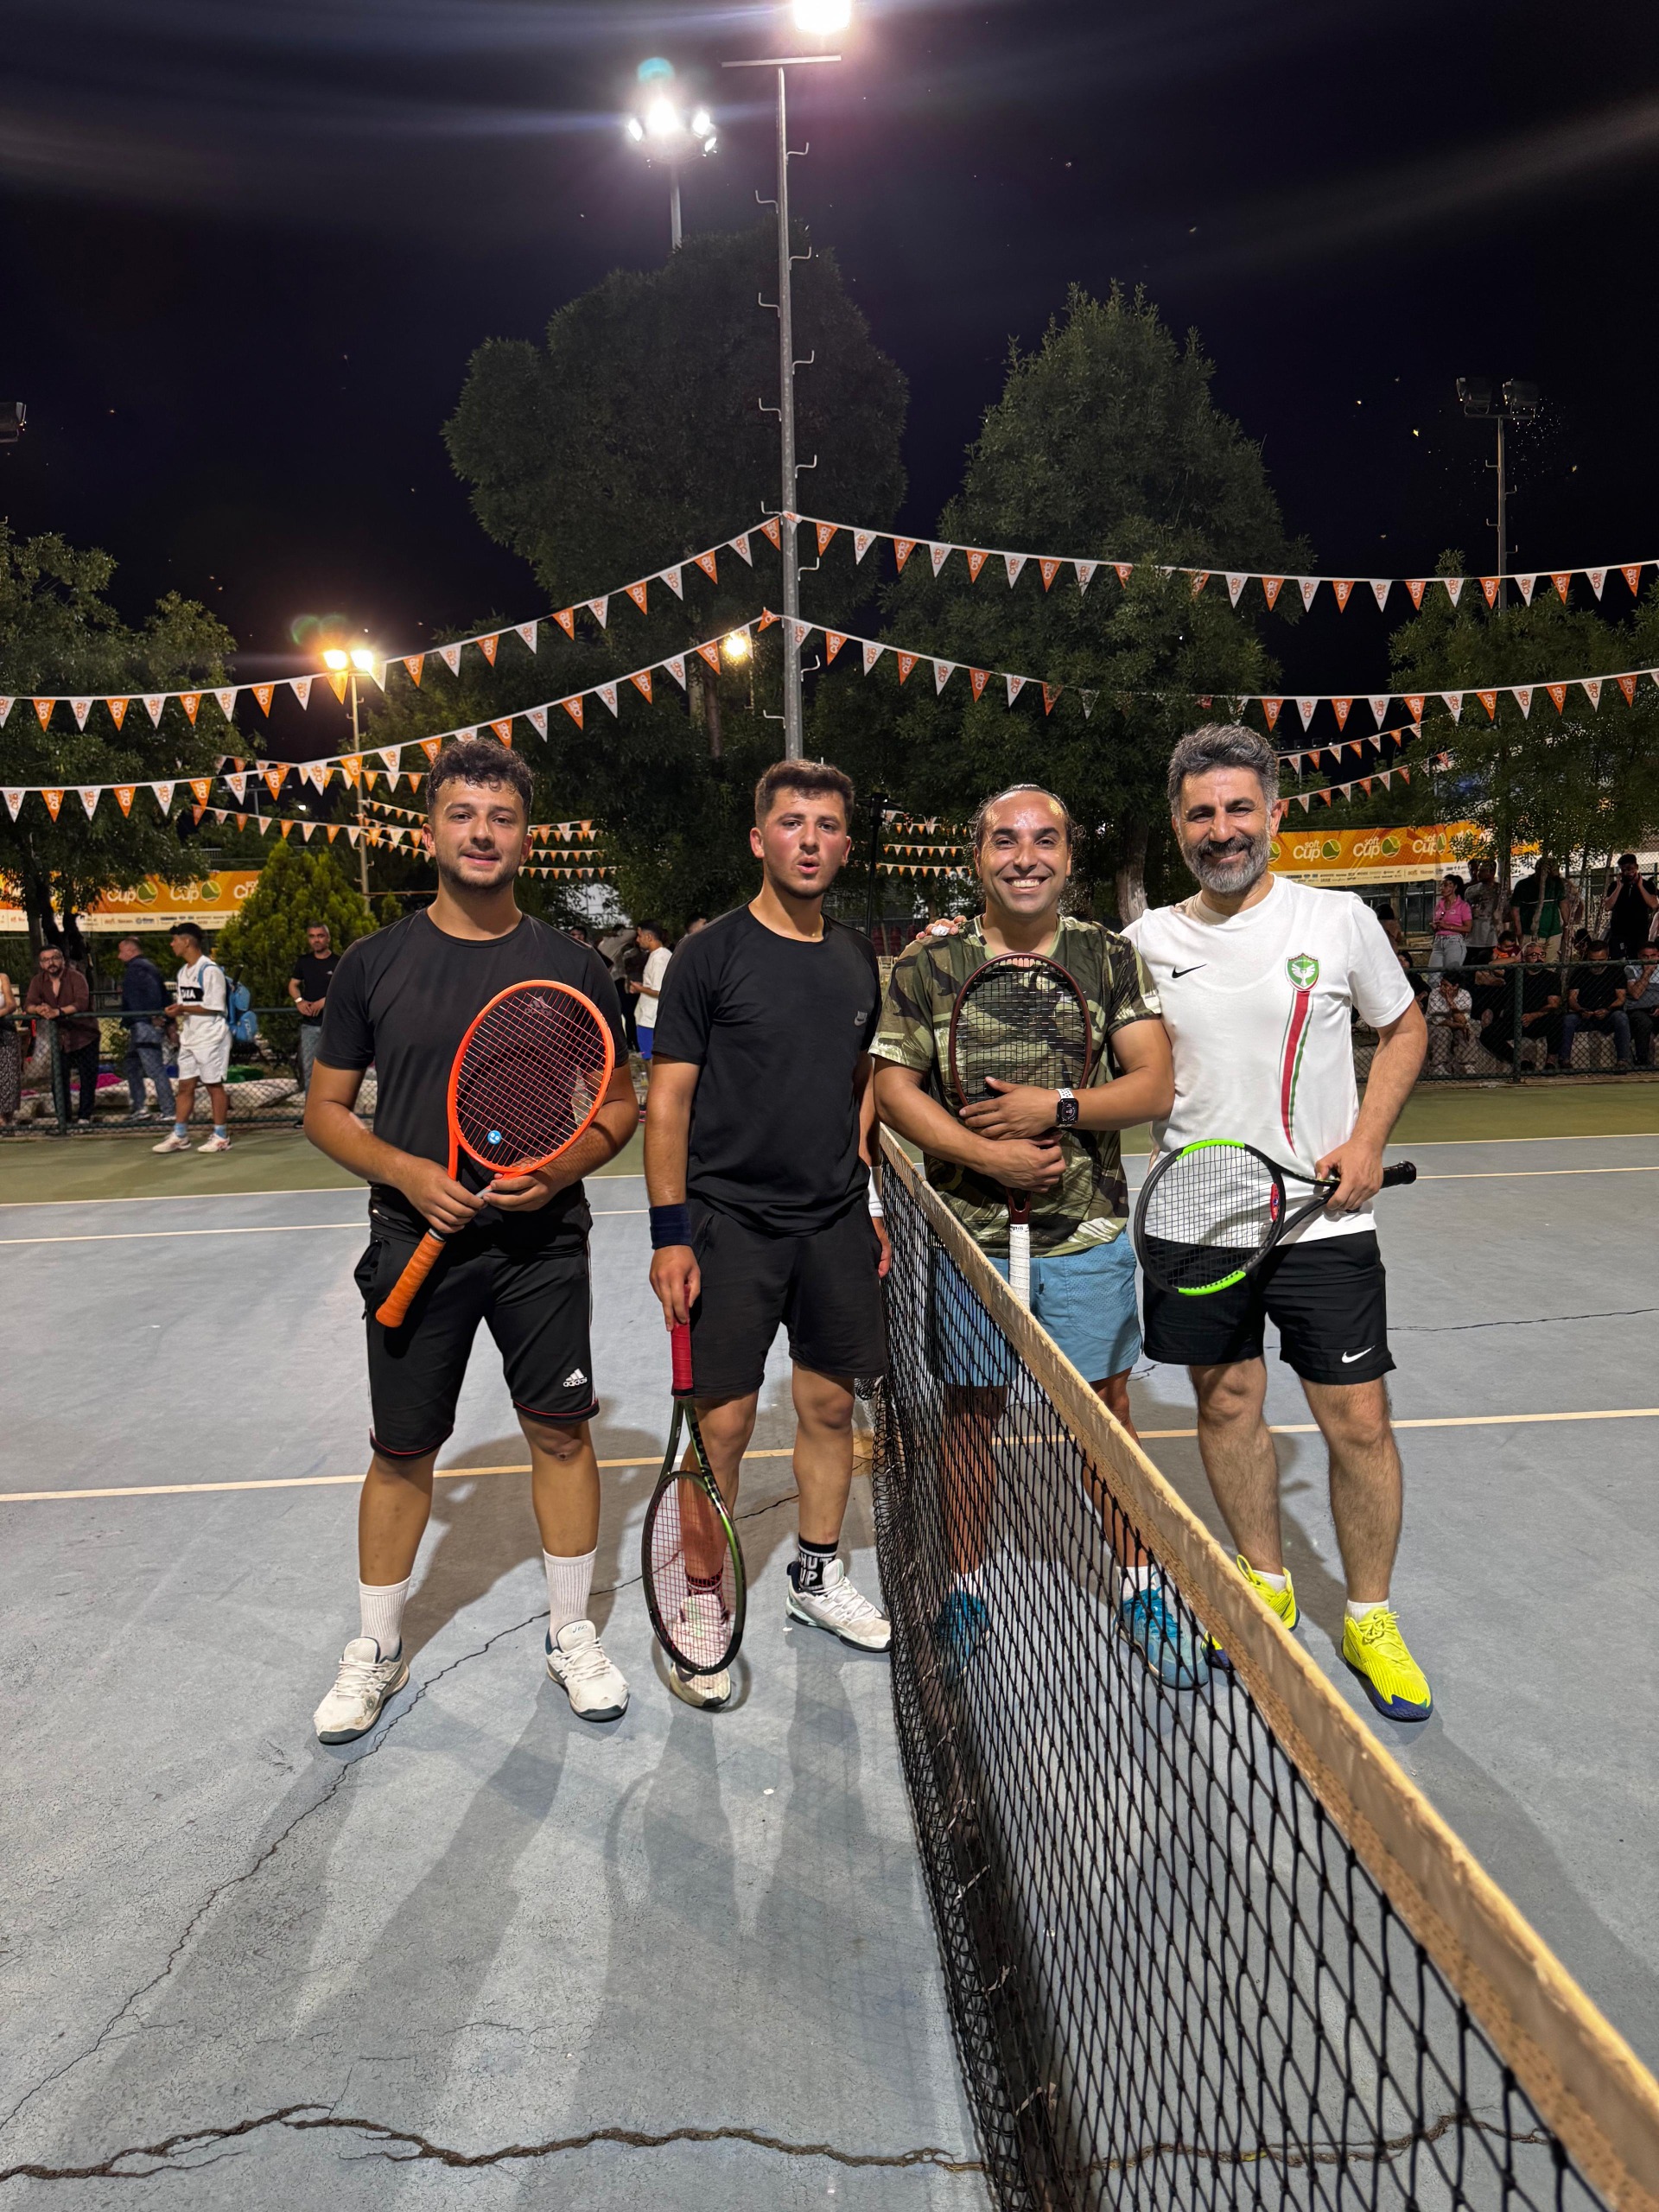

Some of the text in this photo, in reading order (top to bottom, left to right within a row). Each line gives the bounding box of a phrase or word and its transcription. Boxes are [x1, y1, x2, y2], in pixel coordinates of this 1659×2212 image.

[1293, 845, 1321, 861] Cup
[1353, 842, 1381, 859] Cup
[799, 1552, 833, 1570] HUT
[800, 1568, 817, 1586] UP
